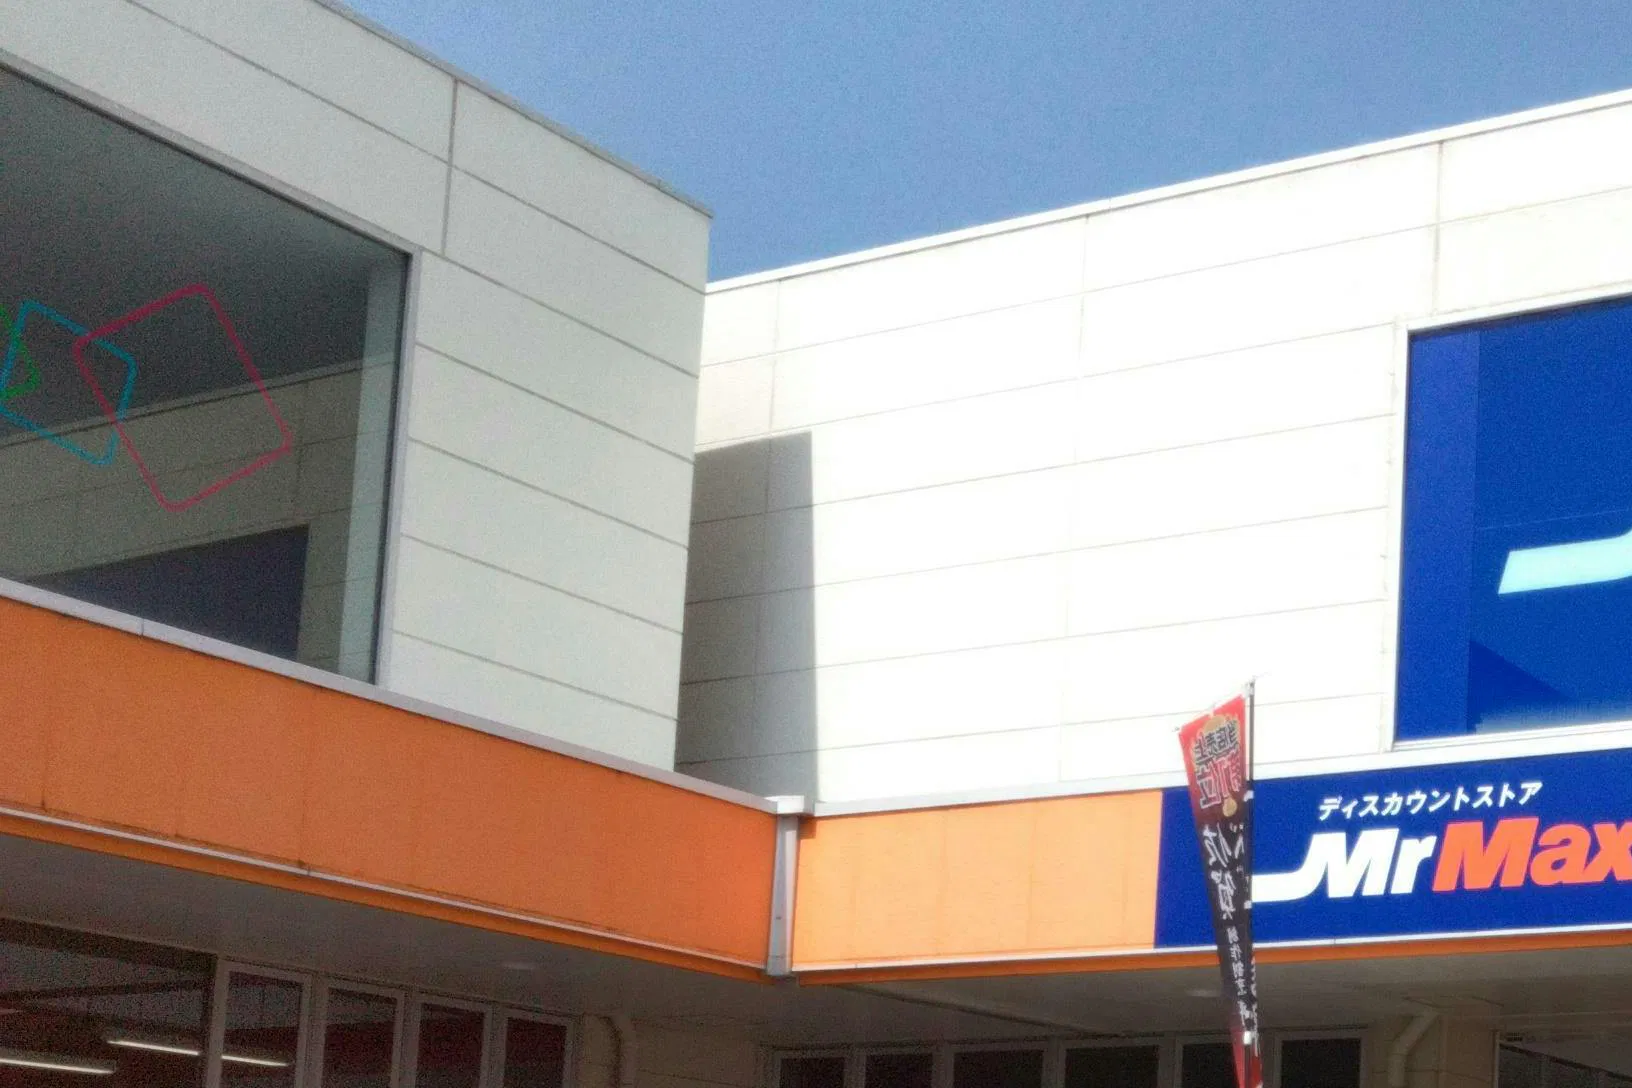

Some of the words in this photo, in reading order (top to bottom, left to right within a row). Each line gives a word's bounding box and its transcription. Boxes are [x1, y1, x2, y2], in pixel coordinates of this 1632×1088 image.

[1318, 781, 1543, 821] ディスカウントストア
